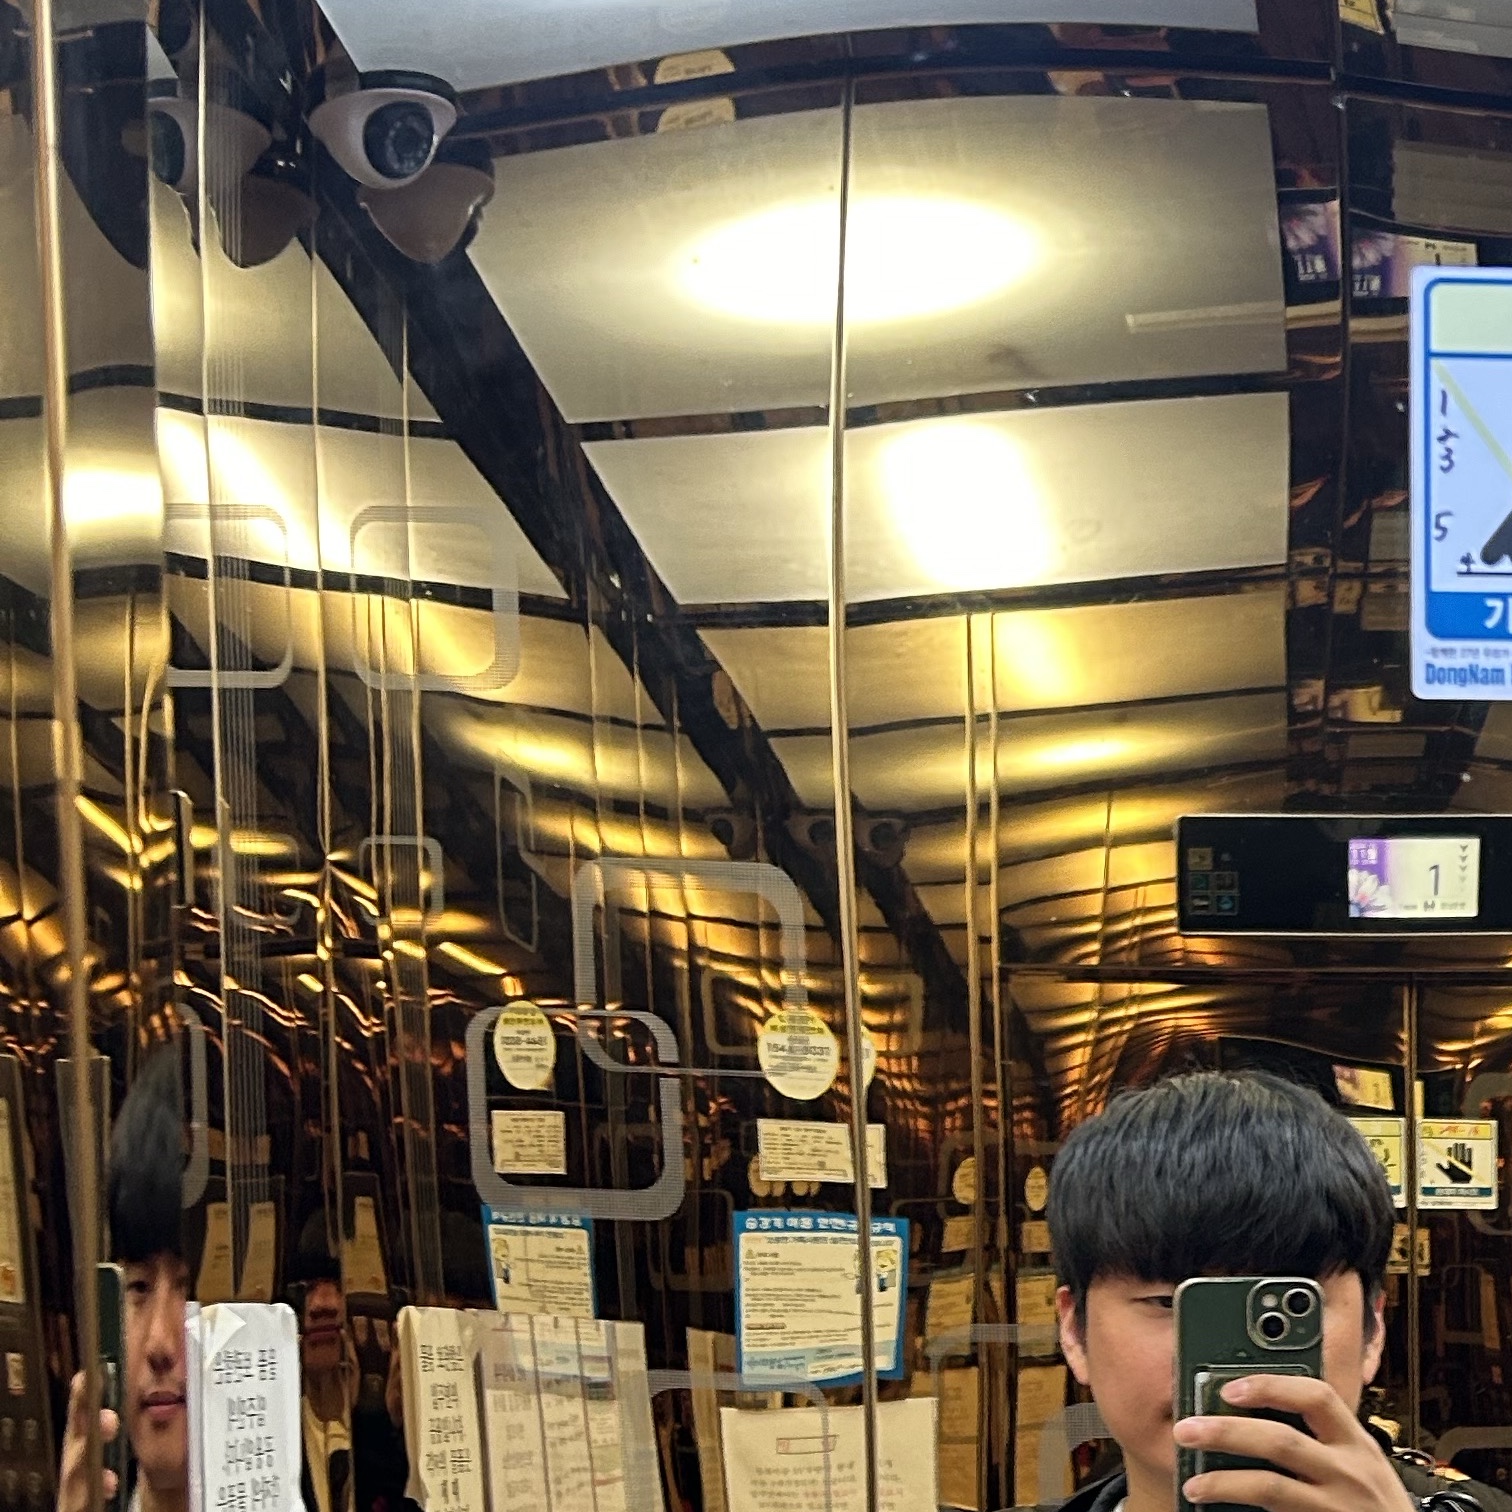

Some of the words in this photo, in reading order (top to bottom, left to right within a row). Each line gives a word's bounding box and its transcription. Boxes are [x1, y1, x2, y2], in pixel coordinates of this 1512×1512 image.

[1433, 511, 1454, 543] 5
[1425, 662, 1505, 688] DongNam
[1428, 863, 1440, 897] 1
